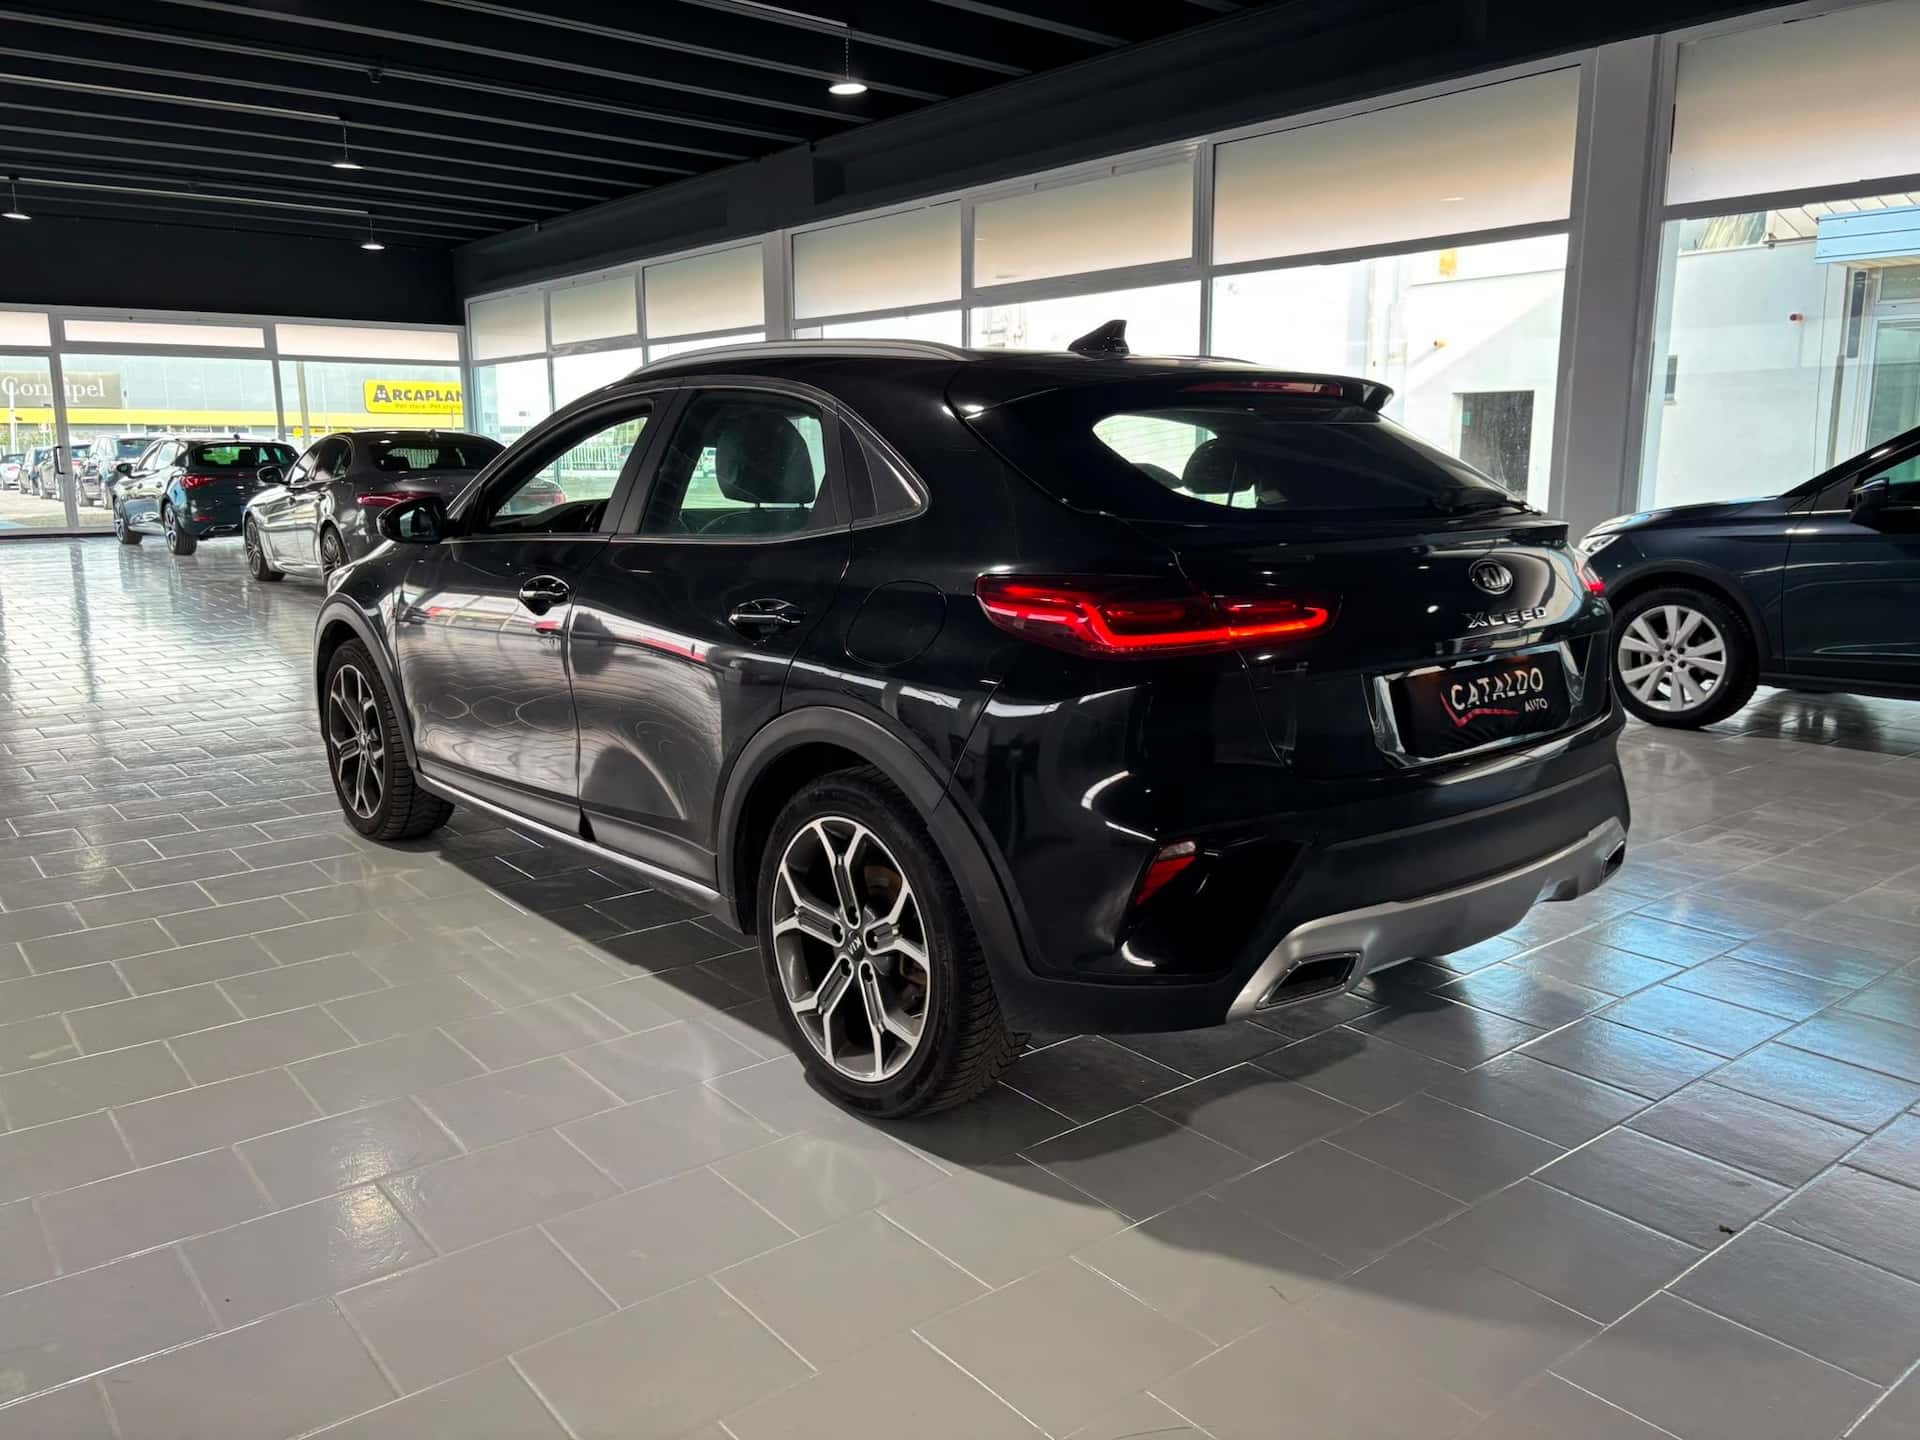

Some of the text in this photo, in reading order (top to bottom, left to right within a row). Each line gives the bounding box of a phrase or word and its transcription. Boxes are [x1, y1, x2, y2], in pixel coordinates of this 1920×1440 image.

[1, 376, 106, 404] Conipel
[1450, 667, 1544, 711] CATALDO
[1524, 697, 1549, 713] AUTO
